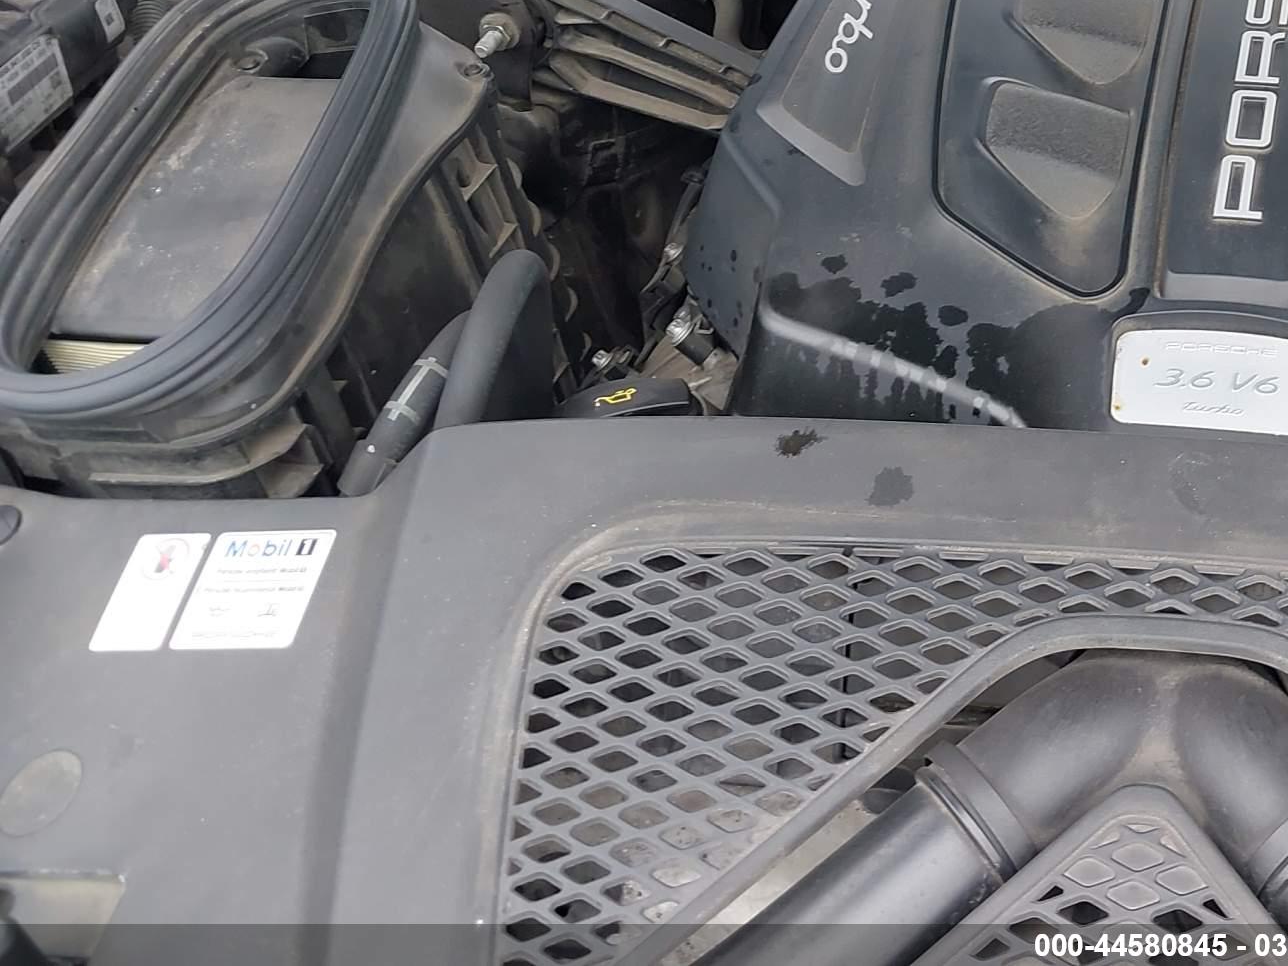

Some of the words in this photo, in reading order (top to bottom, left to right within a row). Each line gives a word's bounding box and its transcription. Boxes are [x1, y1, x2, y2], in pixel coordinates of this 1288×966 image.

[1165, 341, 1279, 358] PORSCHE
[1153, 367, 1214, 389] 3.6
[1231, 371, 1279, 394] V6
[225, 538, 292, 558] Mobil
[295, 538, 319, 556] 1
